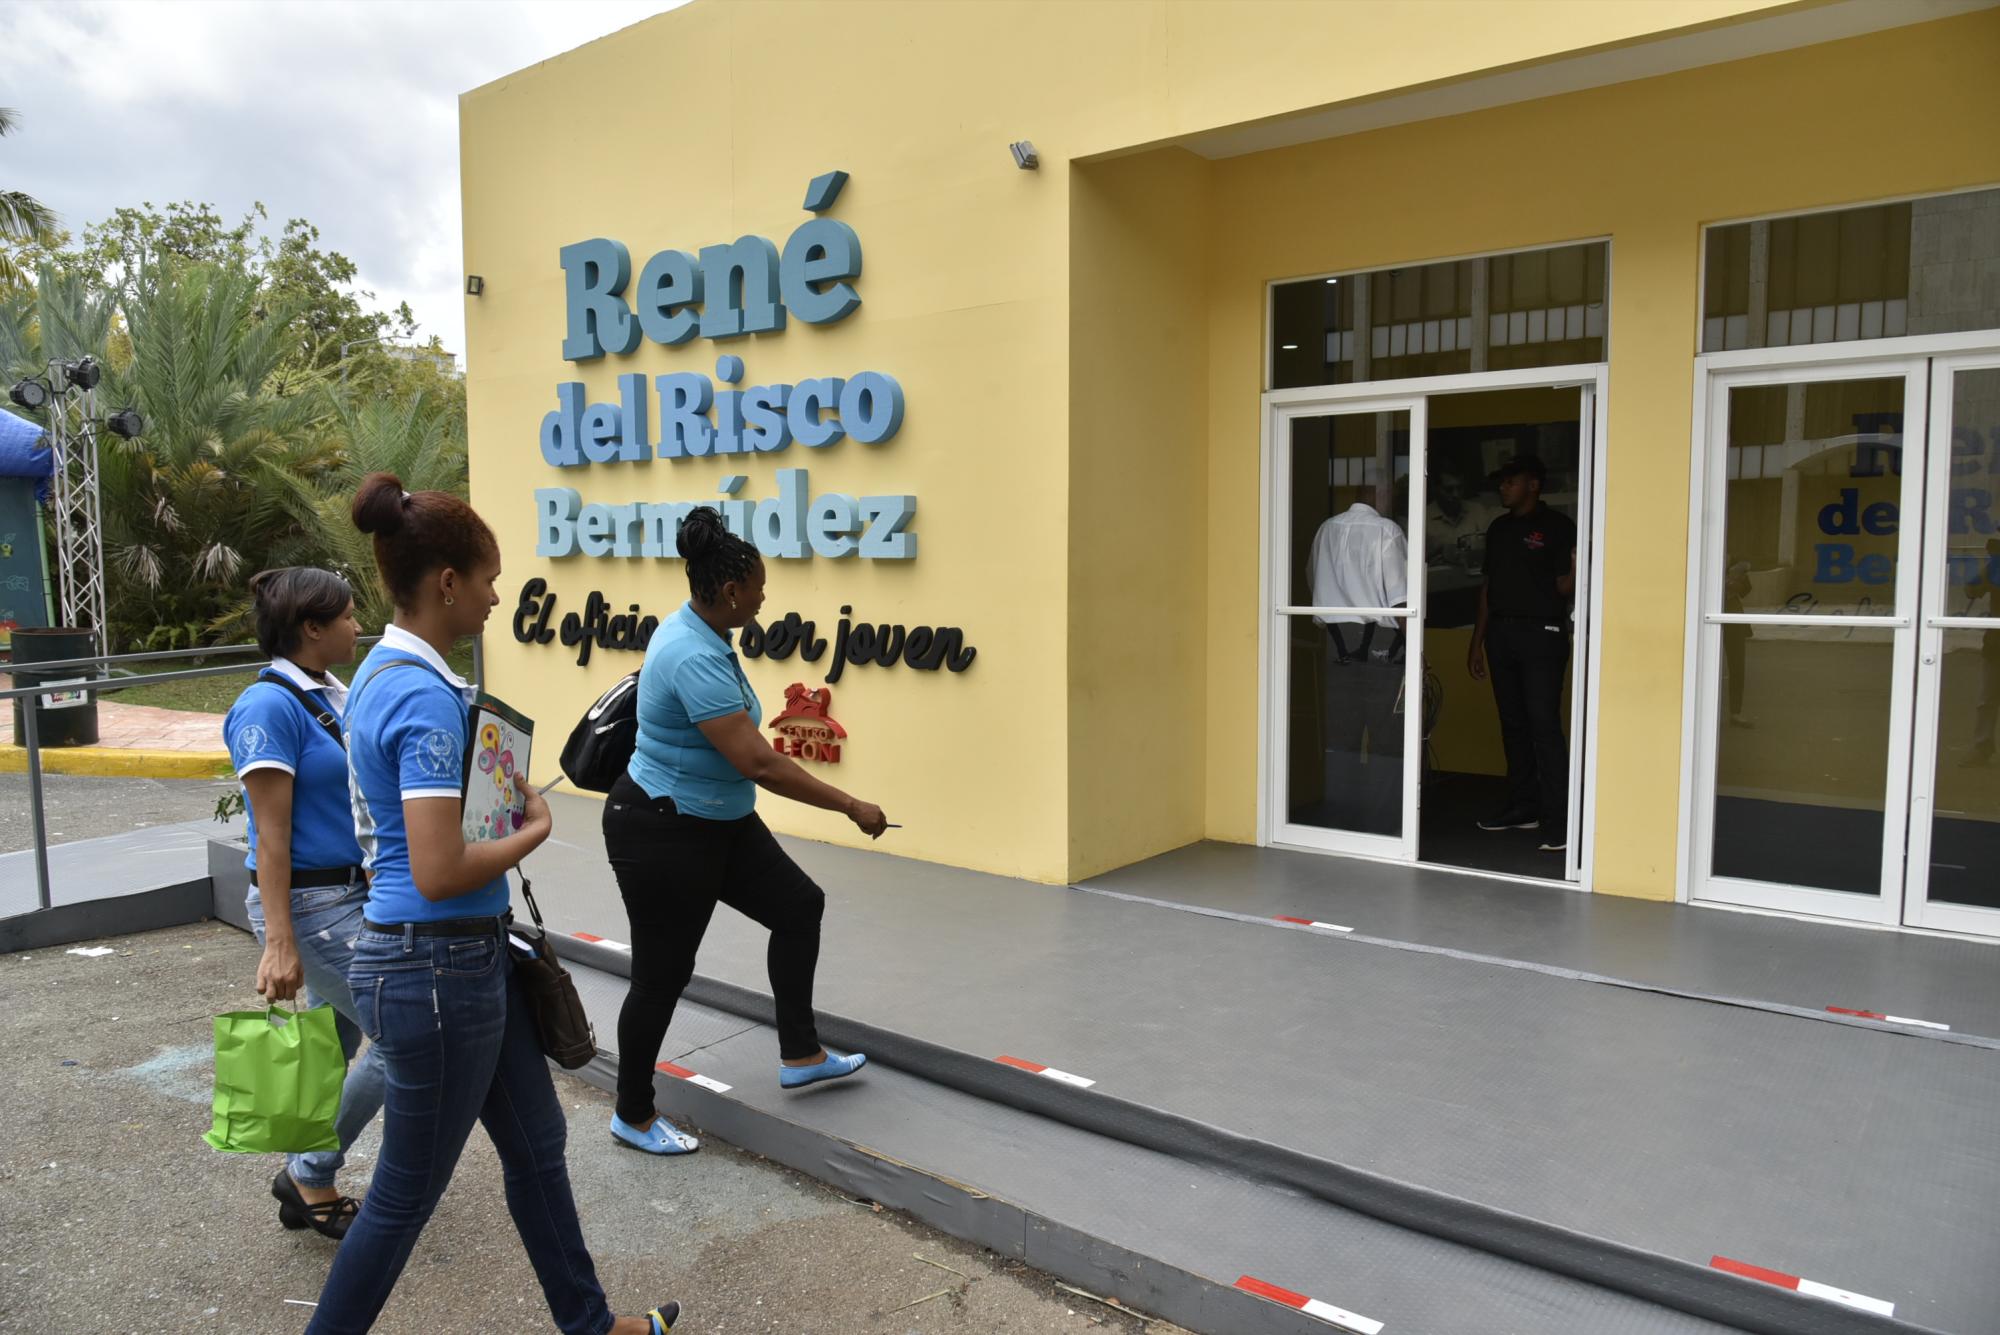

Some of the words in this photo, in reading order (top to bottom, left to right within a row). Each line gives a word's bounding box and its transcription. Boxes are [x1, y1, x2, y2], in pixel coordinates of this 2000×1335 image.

[560, 169, 863, 361] René
[540, 381, 653, 468] del
[655, 355, 905, 459] Risco
[513, 577, 557, 644] El
[739, 612, 828, 662] ser
[824, 605, 977, 683] joven
